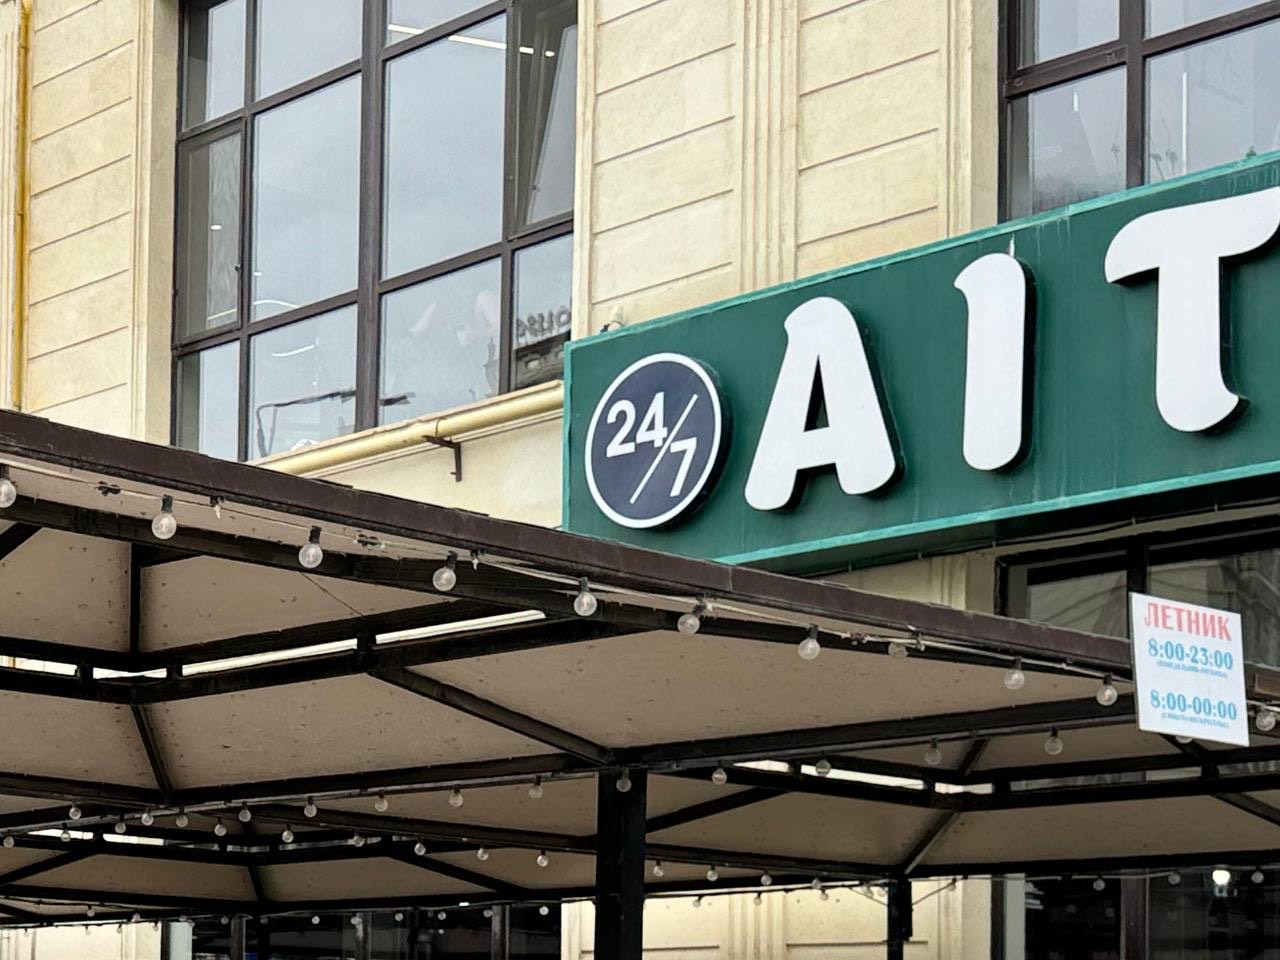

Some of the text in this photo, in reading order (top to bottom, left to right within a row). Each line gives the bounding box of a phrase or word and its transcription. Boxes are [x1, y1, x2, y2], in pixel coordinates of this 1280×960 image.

[606, 391, 698, 504] 24/7
[1145, 602, 1232, 641] ЛЕТНИК
[1148, 638, 1234, 671] 8:00-23:00
[1150, 689, 1237, 721] 8:00-00:00
